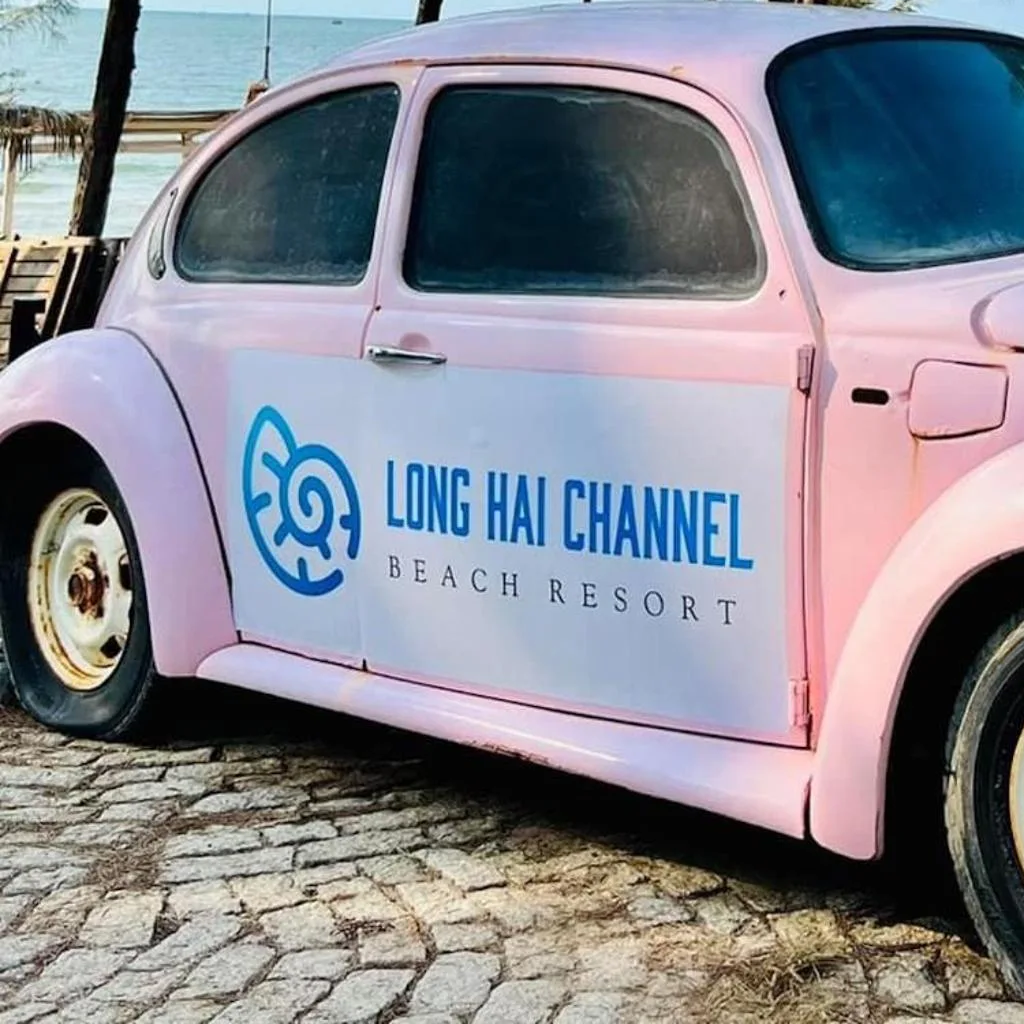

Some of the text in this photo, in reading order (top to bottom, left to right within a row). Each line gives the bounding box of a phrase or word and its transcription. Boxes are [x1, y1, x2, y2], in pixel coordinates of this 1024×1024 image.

[386, 460, 754, 570] LONG HAI CHANNEL
[388, 555, 737, 625] BEACH RESORT
